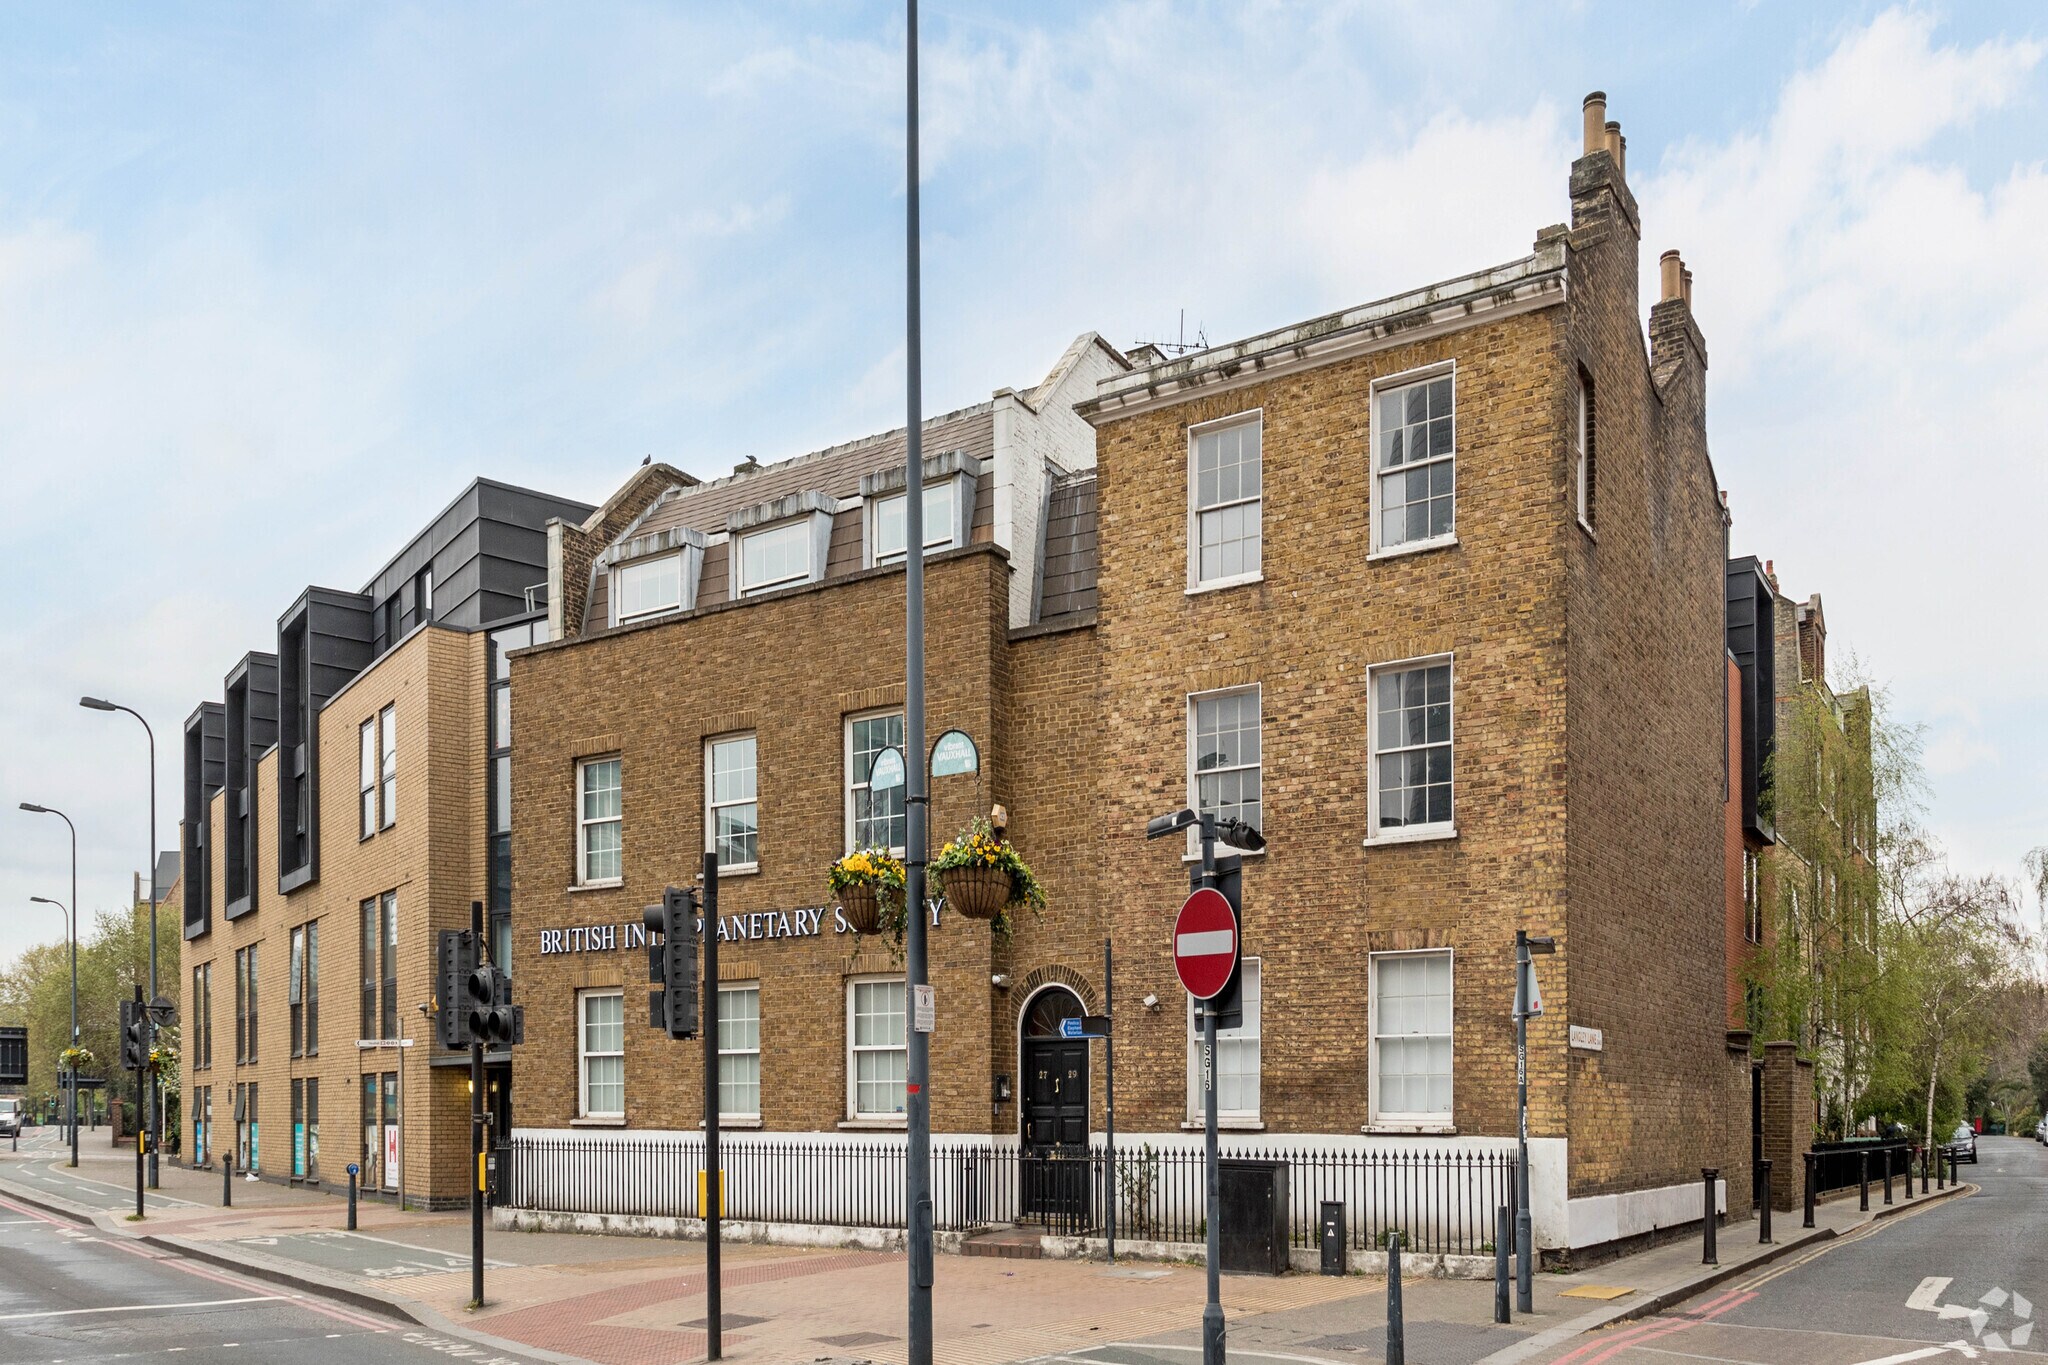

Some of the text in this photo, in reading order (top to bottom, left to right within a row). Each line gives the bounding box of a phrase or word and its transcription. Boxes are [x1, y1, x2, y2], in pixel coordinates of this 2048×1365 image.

[937, 748, 971, 761] VAUXHALL
[541, 924, 616, 954] BRITISH
[624, 907, 825, 948] INANETARY
[1038, 1070, 1048, 1079] 27
[1067, 1069, 1078, 1079] 29
